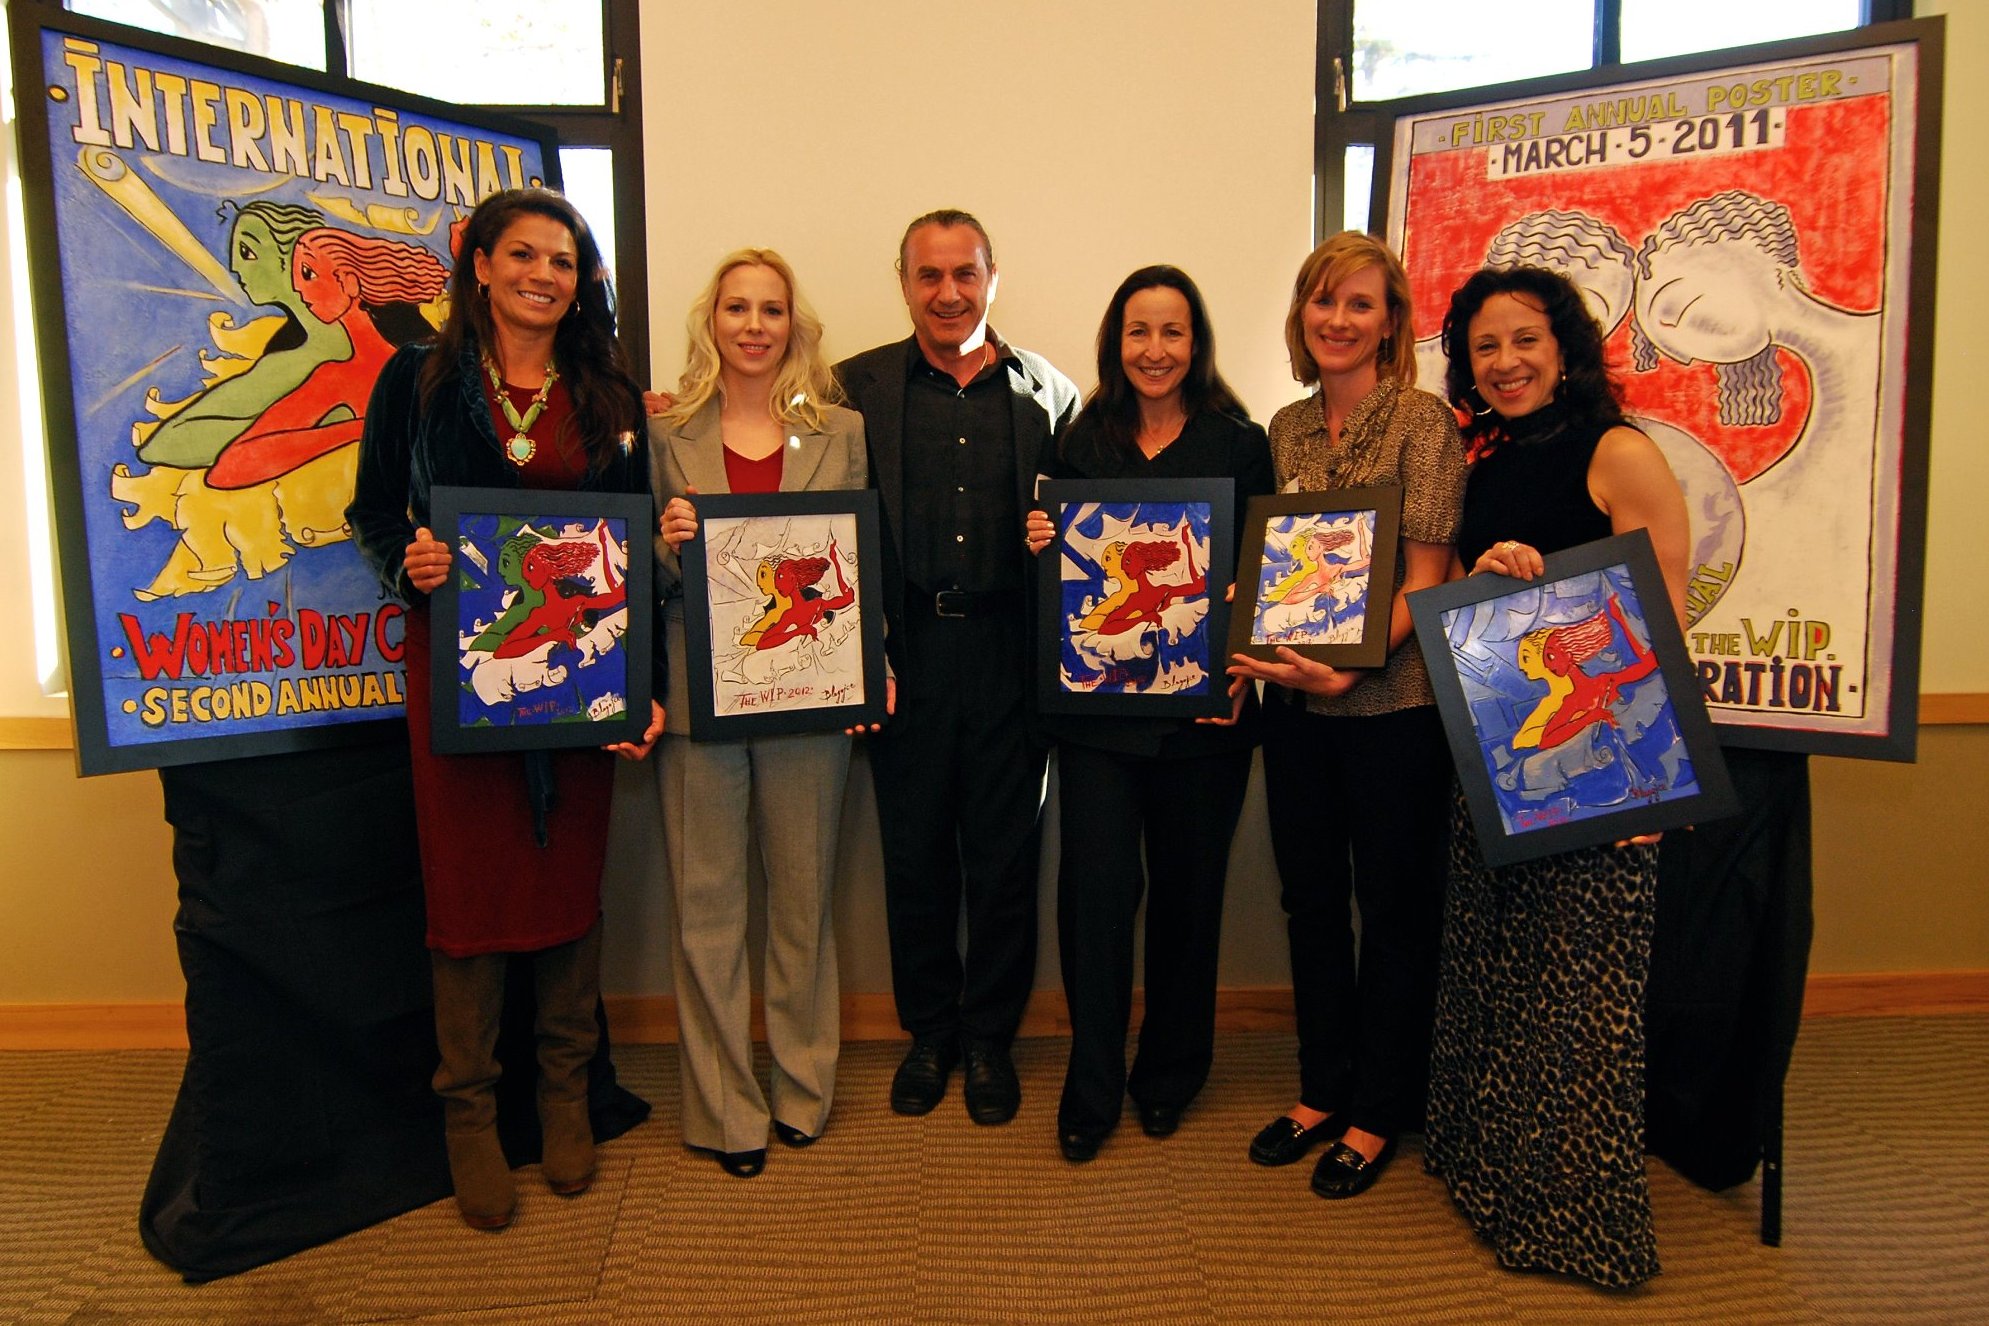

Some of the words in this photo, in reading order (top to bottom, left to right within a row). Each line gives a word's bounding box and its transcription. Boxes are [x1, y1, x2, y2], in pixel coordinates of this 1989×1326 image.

[1451, 110, 1546, 147] FIRST
[1565, 91, 1688, 132] ANNUAL
[1707, 68, 1844, 112] POSTER
[298, 608, 371, 670] DAY
[1691, 632, 1741, 656] THE
[140, 680, 272, 729] SECOND
[277, 672, 405, 717] ANNUAL
[1696, 656, 1843, 713] RATION
